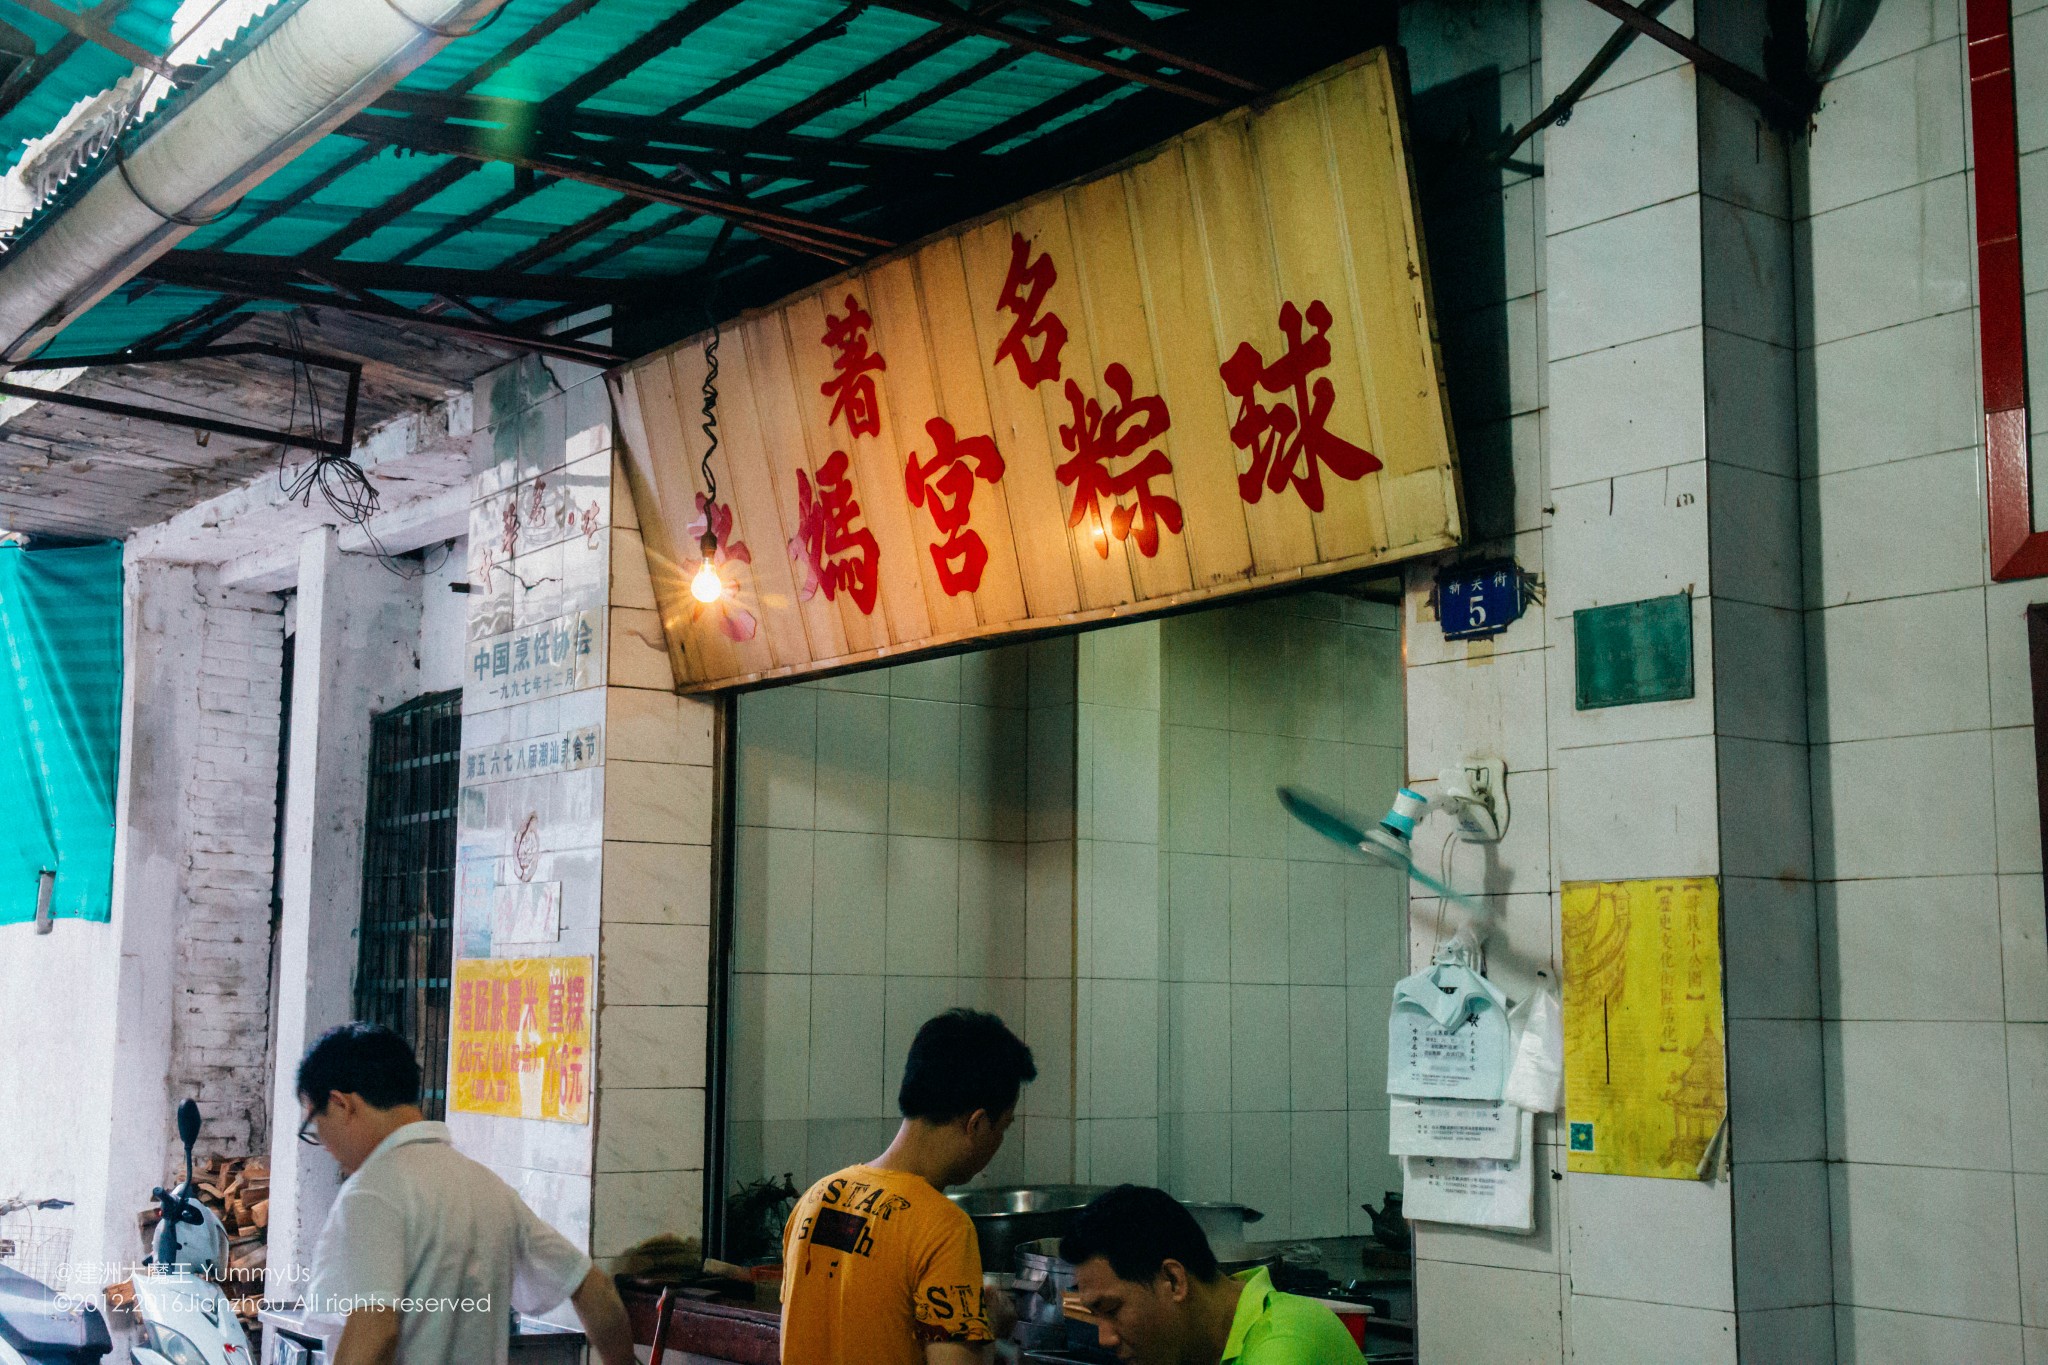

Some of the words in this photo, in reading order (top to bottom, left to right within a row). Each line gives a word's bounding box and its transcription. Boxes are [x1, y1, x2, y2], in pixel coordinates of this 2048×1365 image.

[1469, 595, 1487, 627] 5
[474, 620, 593, 681] 中国烹饪协会
[489, 667, 574, 699] 一九九七年十二月
[465, 731, 596, 780] 第五六七八届潮汕美食节
[822, 1178, 911, 1220] STAR
